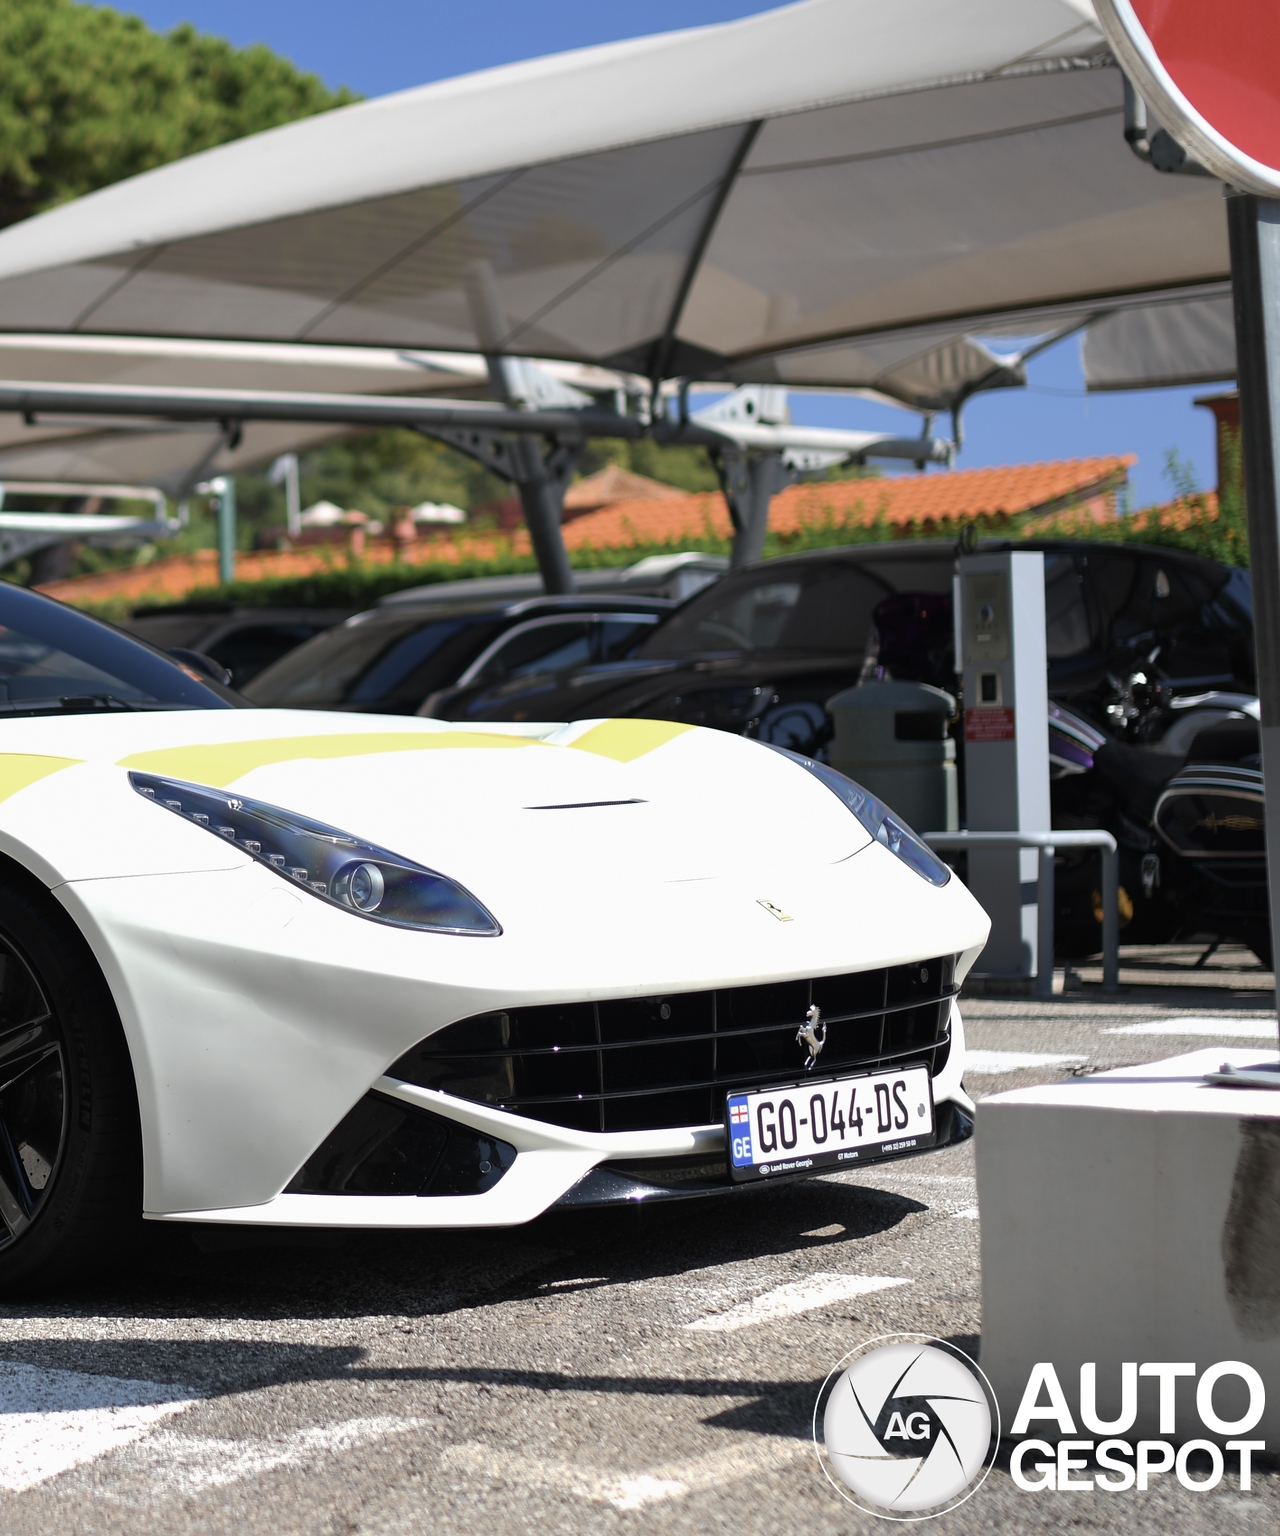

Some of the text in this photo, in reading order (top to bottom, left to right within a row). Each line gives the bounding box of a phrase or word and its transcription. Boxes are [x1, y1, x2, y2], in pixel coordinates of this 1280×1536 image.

[69, 1012, 91, 1126] MICHELIN
[756, 1079, 909, 1154] GO-044-DS
[77, 1139, 88, 1170] PILOT
[733, 1136, 752, 1158] GE
[844, 1151, 859, 1160] Motors
[770, 1163, 782, 1172] Land
[782, 1162, 796, 1170] Rover
[795, 1158, 813, 1168] Georgia
